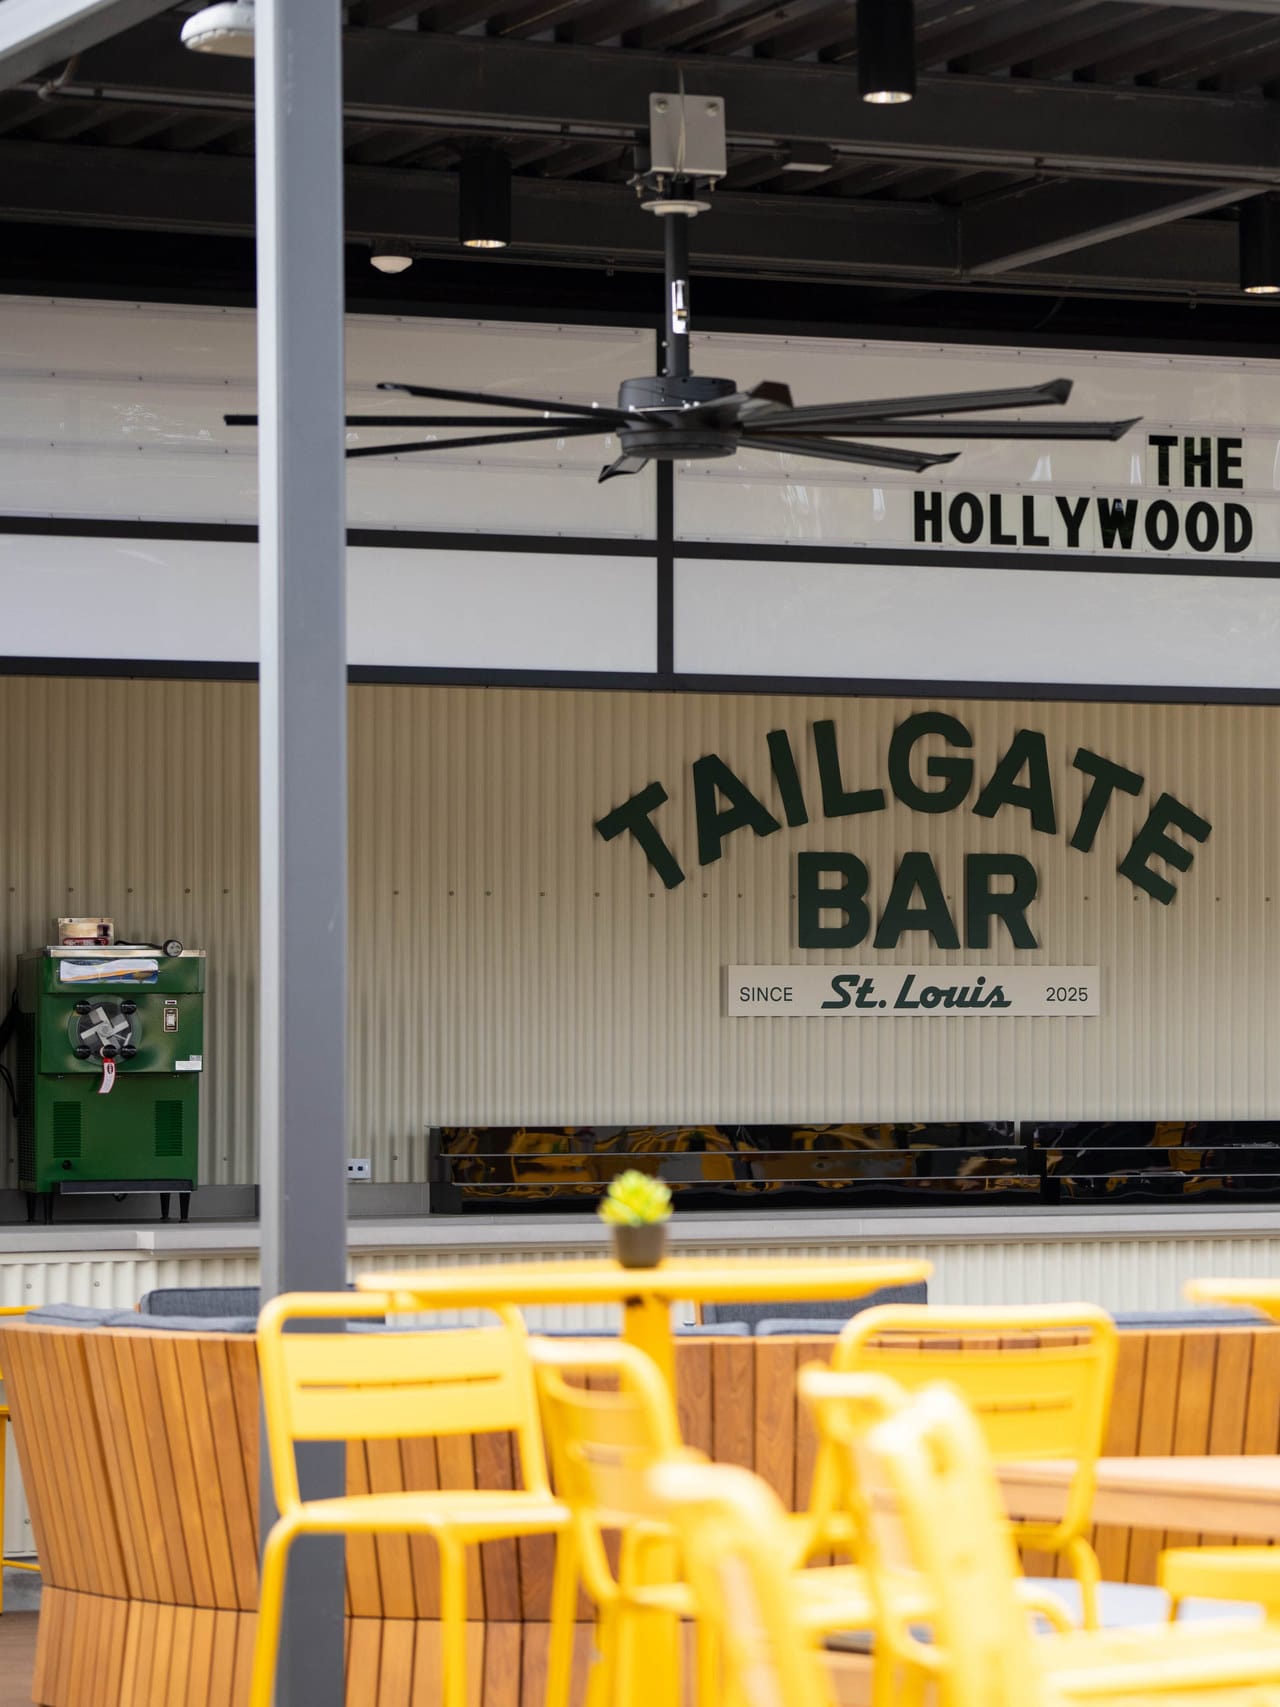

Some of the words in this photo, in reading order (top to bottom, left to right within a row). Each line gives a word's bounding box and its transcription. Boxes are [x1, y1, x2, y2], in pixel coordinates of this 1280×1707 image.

[1148, 434, 1244, 489] THE
[913, 490, 1253, 554] HOLLYWOOD
[594, 711, 1213, 906] TAILGATE
[797, 851, 1038, 950] BAR
[739, 986, 793, 1002] SINCE
[820, 974, 887, 1009] St.
[893, 975, 1012, 1010] Louis
[1045, 986, 1088, 1002] 2025
